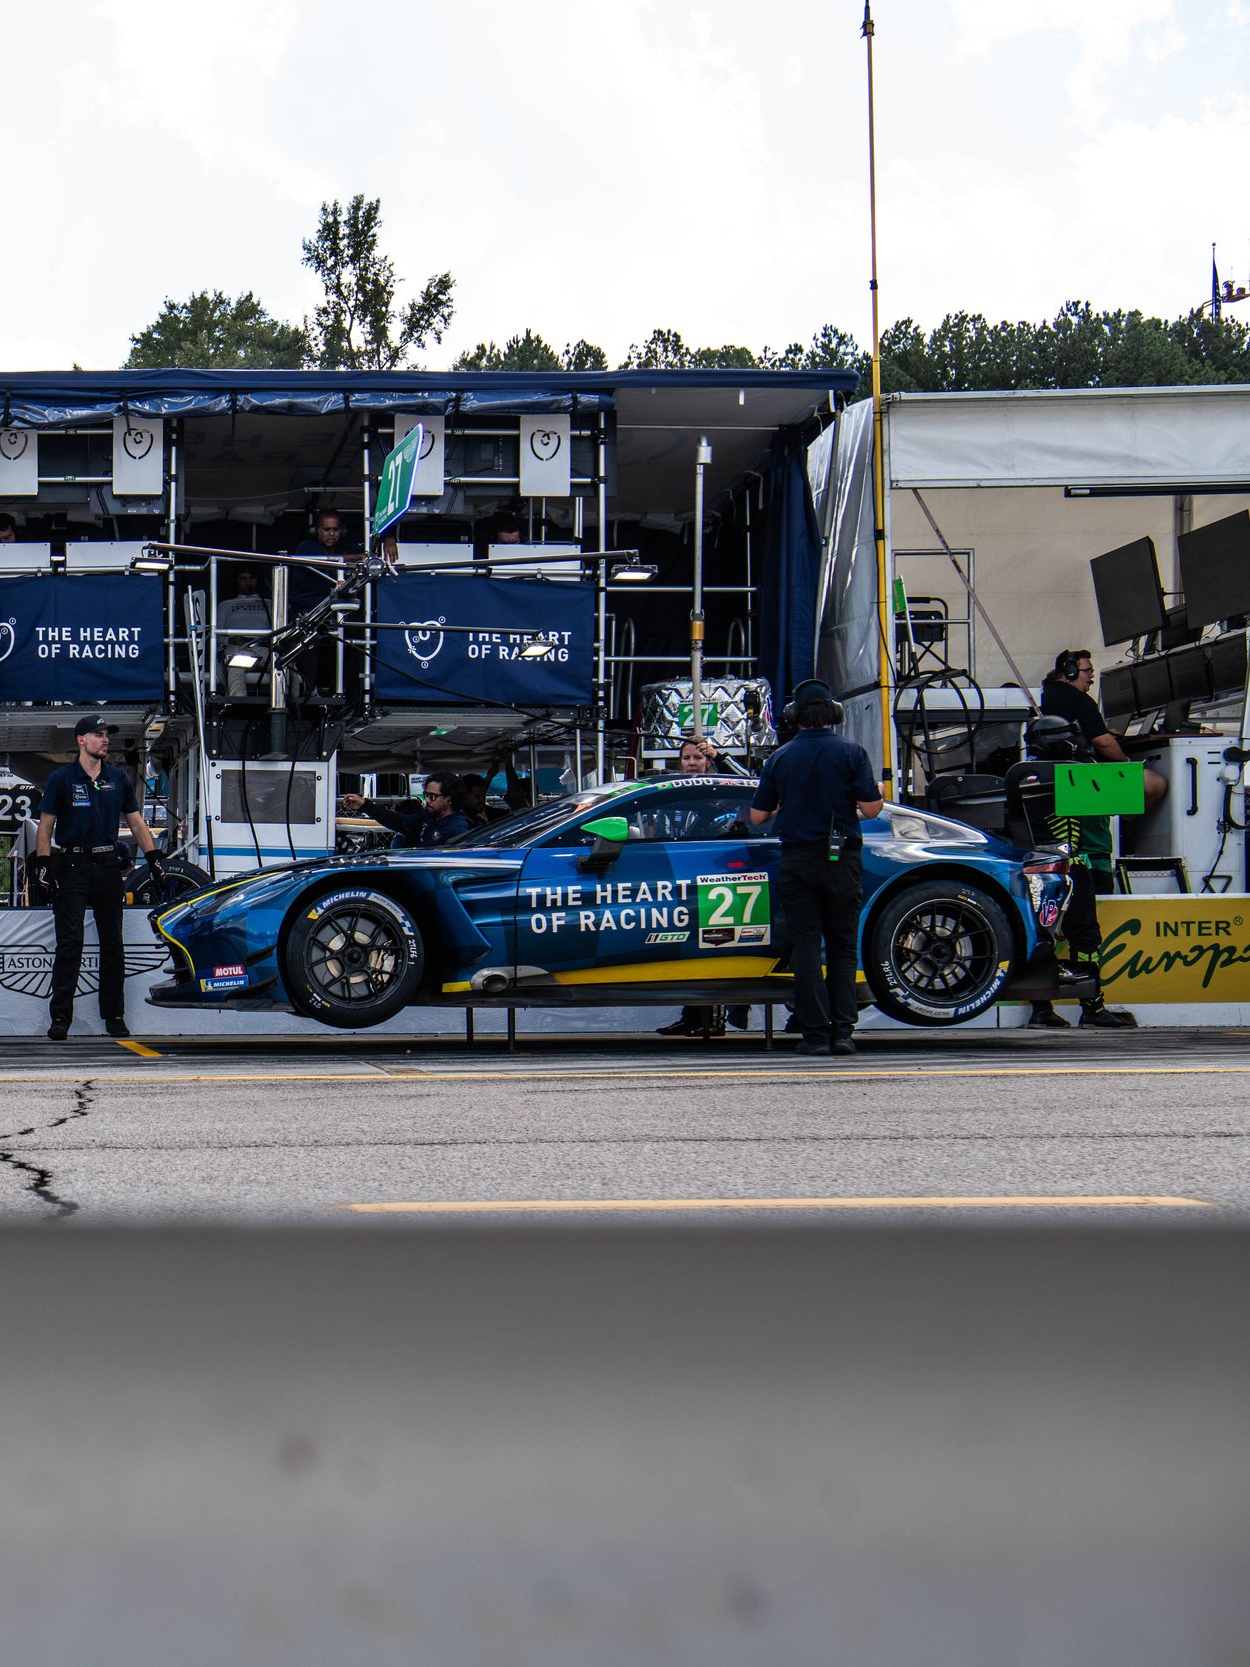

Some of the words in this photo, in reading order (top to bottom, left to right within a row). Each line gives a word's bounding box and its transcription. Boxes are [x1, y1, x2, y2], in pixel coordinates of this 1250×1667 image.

[388, 451, 403, 515] 27
[36, 627, 72, 641] THE
[80, 627, 141, 641] HEART
[468, 632, 502, 643] THE
[38, 644, 61, 658] OF
[69, 644, 140, 659] RACING
[468, 644, 492, 659] OF
[498, 646, 569, 662] RANG
[683, 703, 714, 727] 27
[671, 778, 714, 788] DUDU
[699, 873, 767, 884] WeatherTech
[322, 891, 367, 909] MICHELIN
[526, 885, 582, 908] THE
[596, 879, 691, 905] HEART
[707, 885, 762, 926] 27
[531, 912, 566, 935] OF
[580, 906, 690, 932] RACING
[1155, 920, 1232, 937] INTER
[658, 932, 688, 942] GTD
[7, 957, 53, 969] ASTON
[80, 957, 99, 968] RTI
[215, 966, 244, 977] MOTUL
[213, 980, 244, 988] MICHELIN
[957, 979, 1001, 1015] MICHELIN
